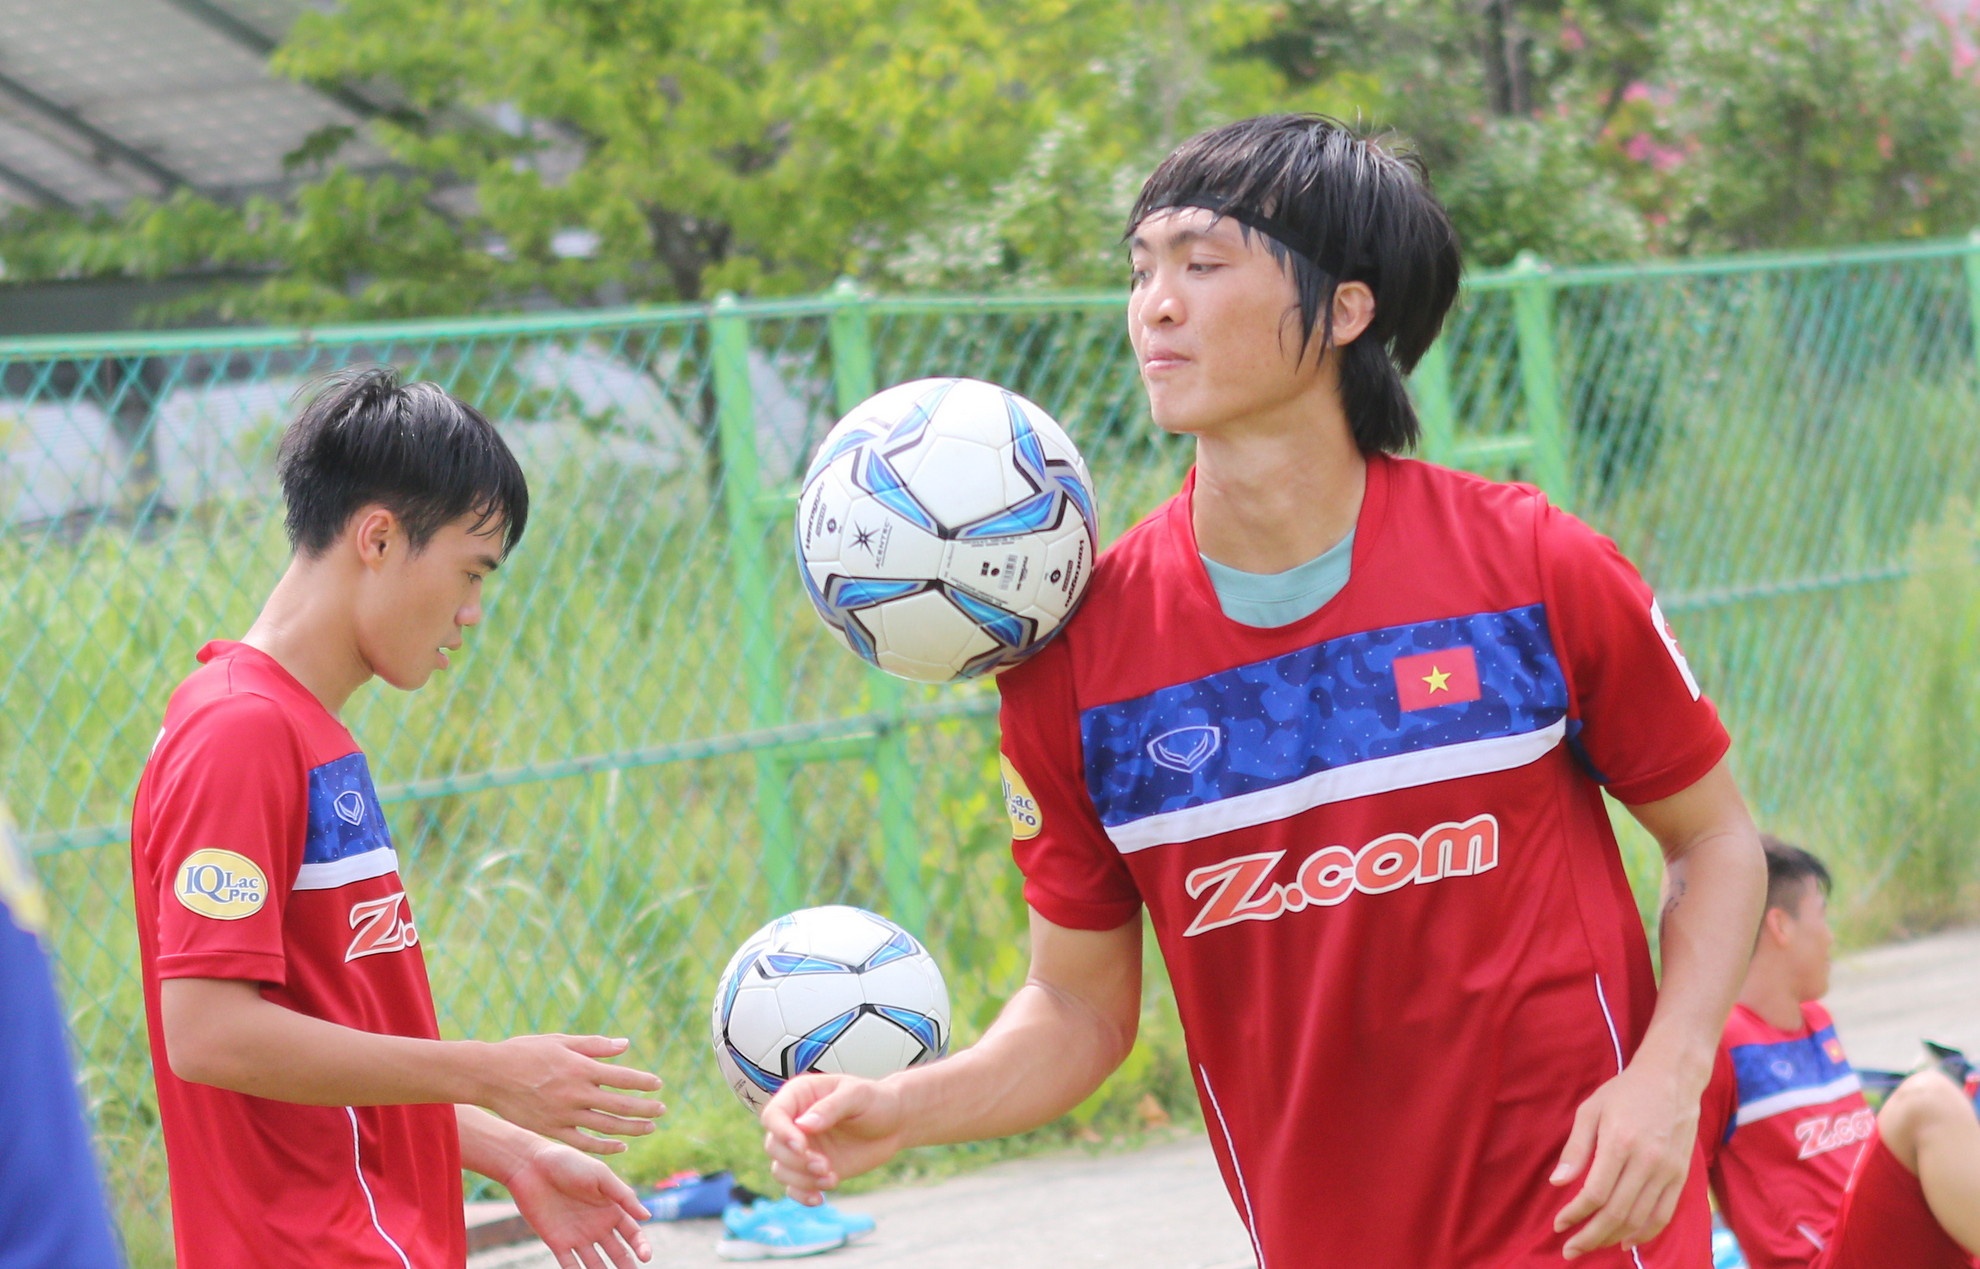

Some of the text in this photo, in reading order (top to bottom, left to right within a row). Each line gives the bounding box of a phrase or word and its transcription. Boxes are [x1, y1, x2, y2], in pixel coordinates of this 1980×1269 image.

[183, 864, 259, 904] IQ Lac
[1182, 813, 1499, 937] Z.com
[229, 889, 260, 903] Pro
